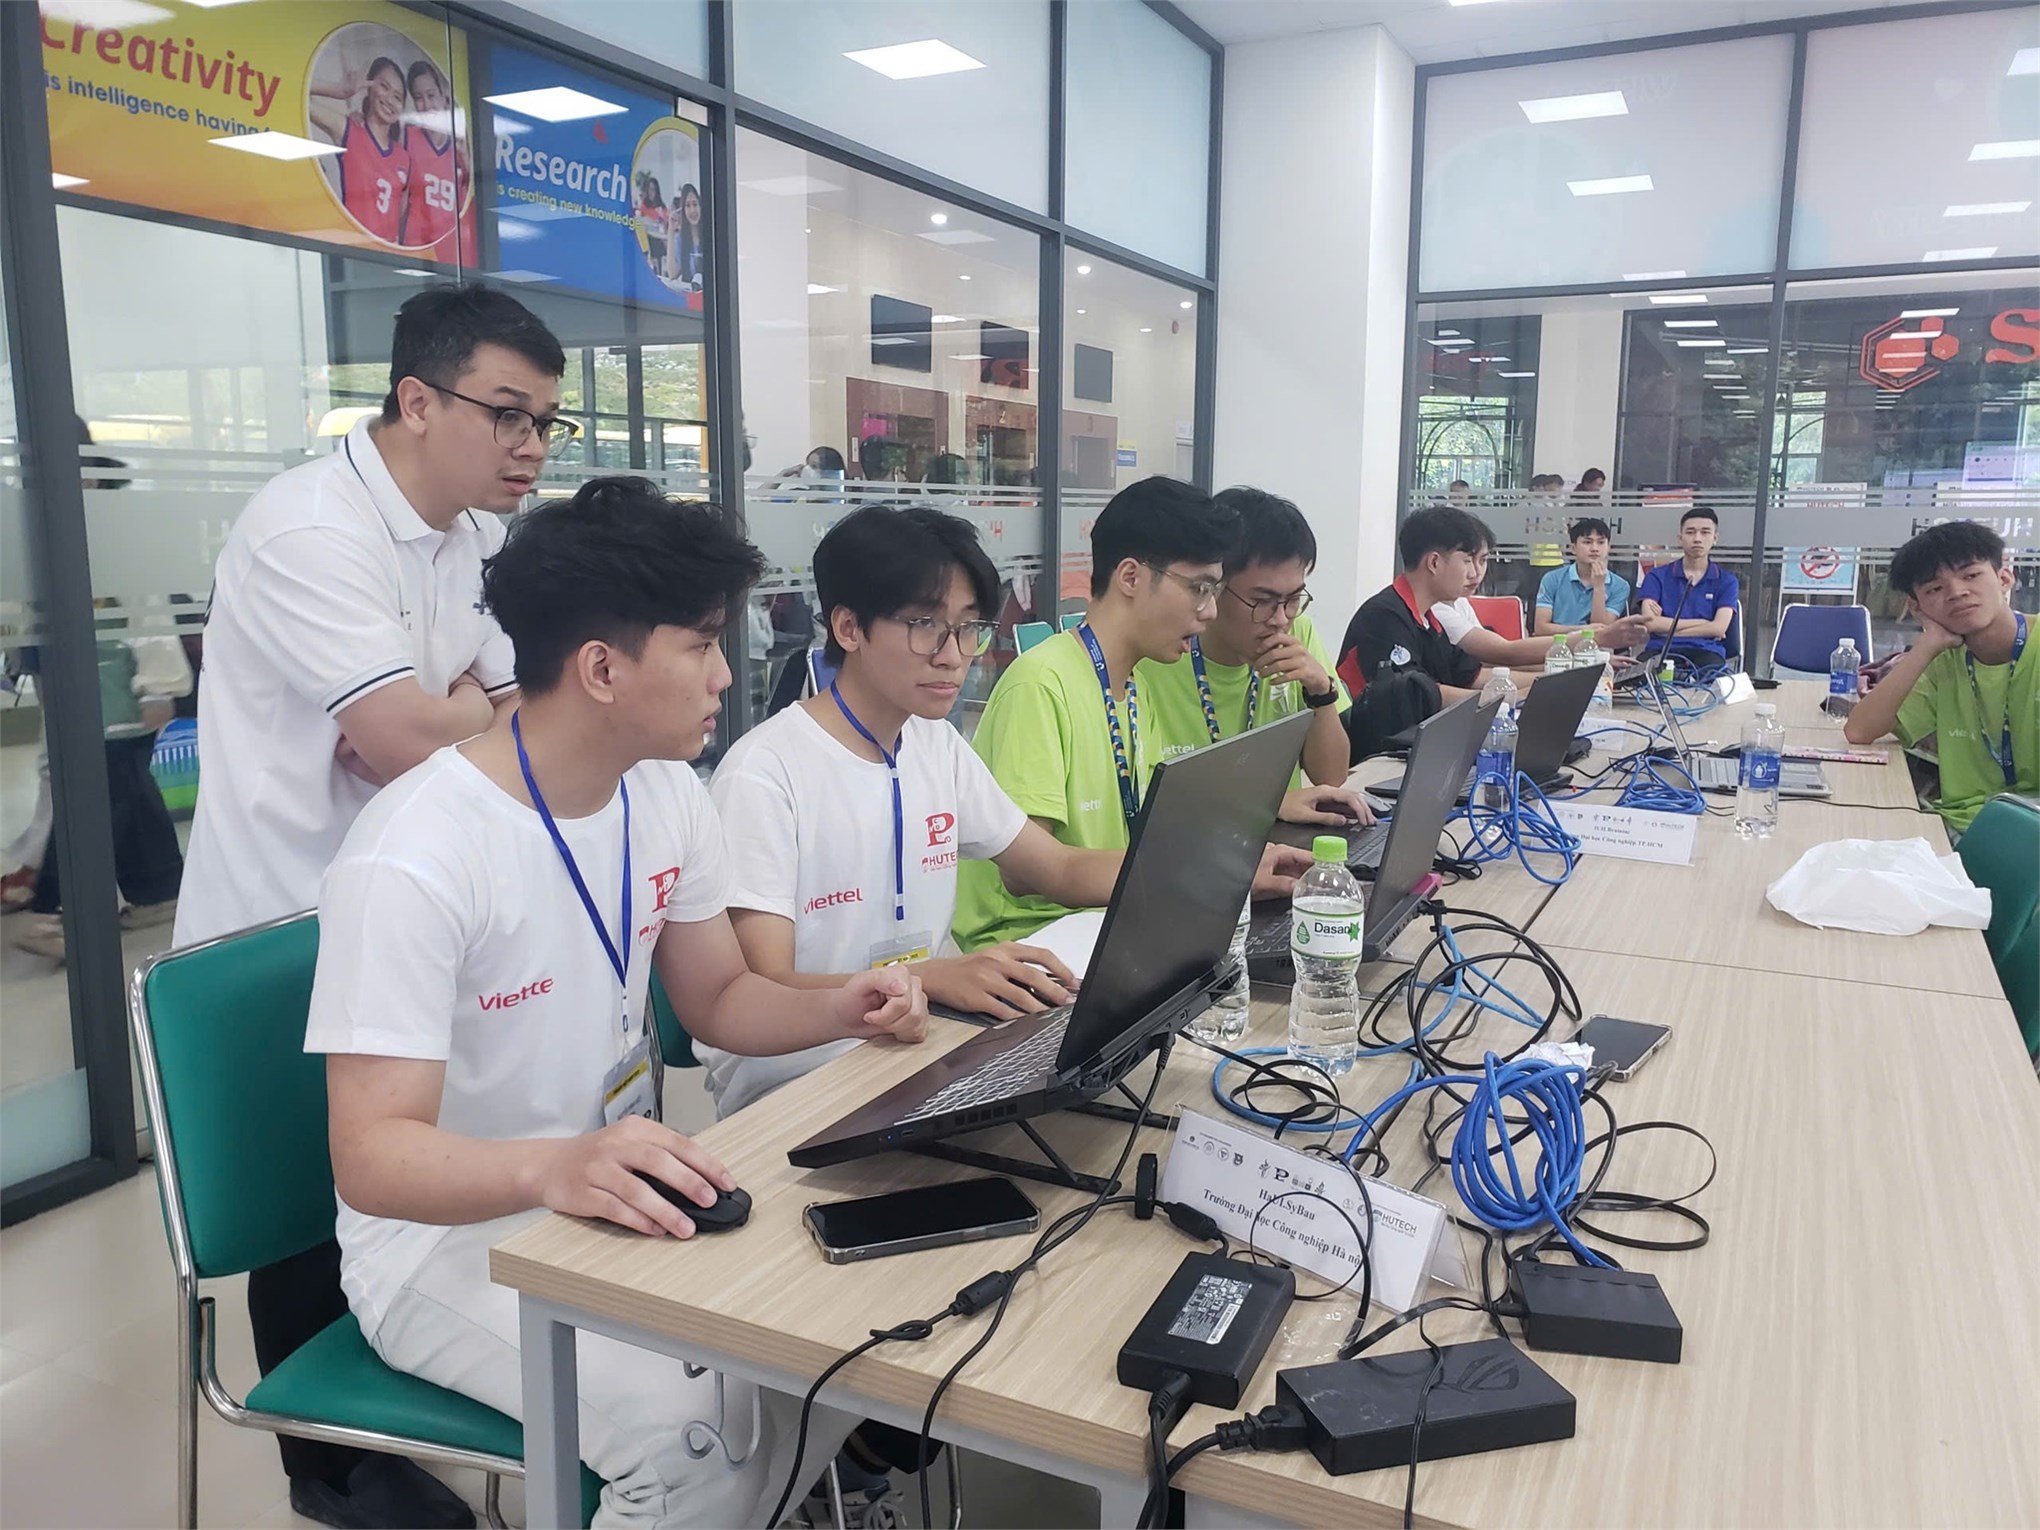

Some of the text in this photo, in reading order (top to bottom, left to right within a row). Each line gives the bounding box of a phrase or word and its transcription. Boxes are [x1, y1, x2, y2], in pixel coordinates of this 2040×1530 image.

[68, 75, 189, 121] intelligence
[496, 134, 628, 203] Research
[376, 178, 392, 214] 3
[424, 173, 456, 212] 29
[508, 186, 557, 211] creating
[560, 199, 583, 214] new
[929, 851, 957, 866] HUTE
[1314, 922, 1352, 935] Dasan
[1382, 1213, 1417, 1234] HUTECH
[1272, 1218, 1298, 1241] Công
[1298, 1232, 1330, 1254] nghiệp
[1331, 1244, 1347, 1260] Hà
[1347, 1254, 1362, 1268] nộ
